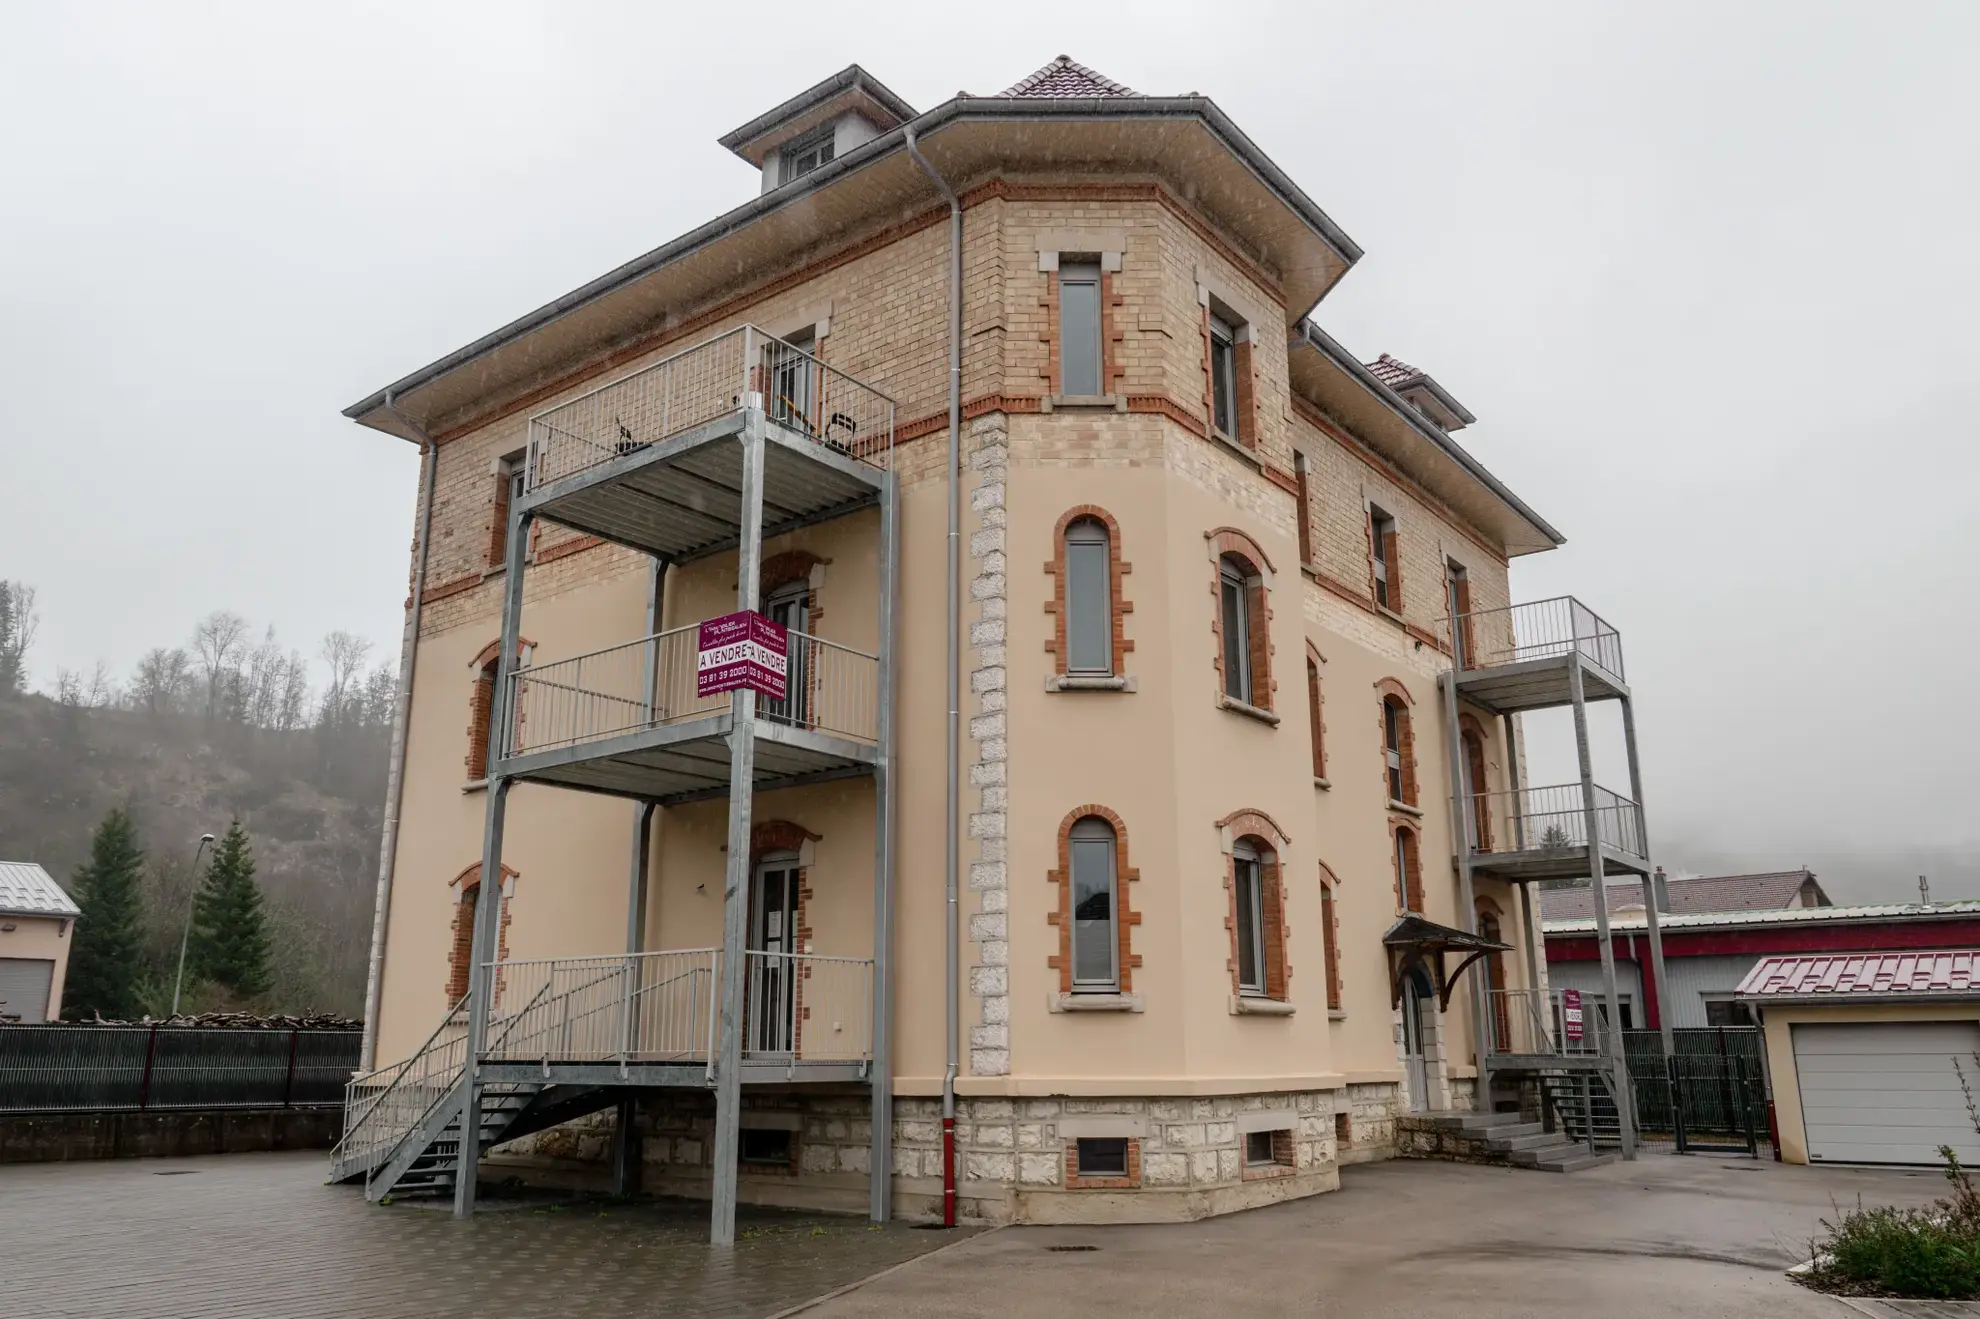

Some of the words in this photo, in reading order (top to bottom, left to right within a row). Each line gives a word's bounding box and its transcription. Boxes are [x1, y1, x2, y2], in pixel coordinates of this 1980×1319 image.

[700, 655, 707, 668] A
[709, 643, 747, 666] VENDRE
[757, 648, 785, 673] VENDRE
[699, 675, 708, 685] 03
[708, 673, 717, 682] 81
[718, 671, 728, 680] 39
[729, 665, 747, 677] 2000
[749, 667, 757, 677] 03
[757, 670, 764, 680] 81
[764, 673, 772, 684] 39
[772, 676, 785, 689] 2000
